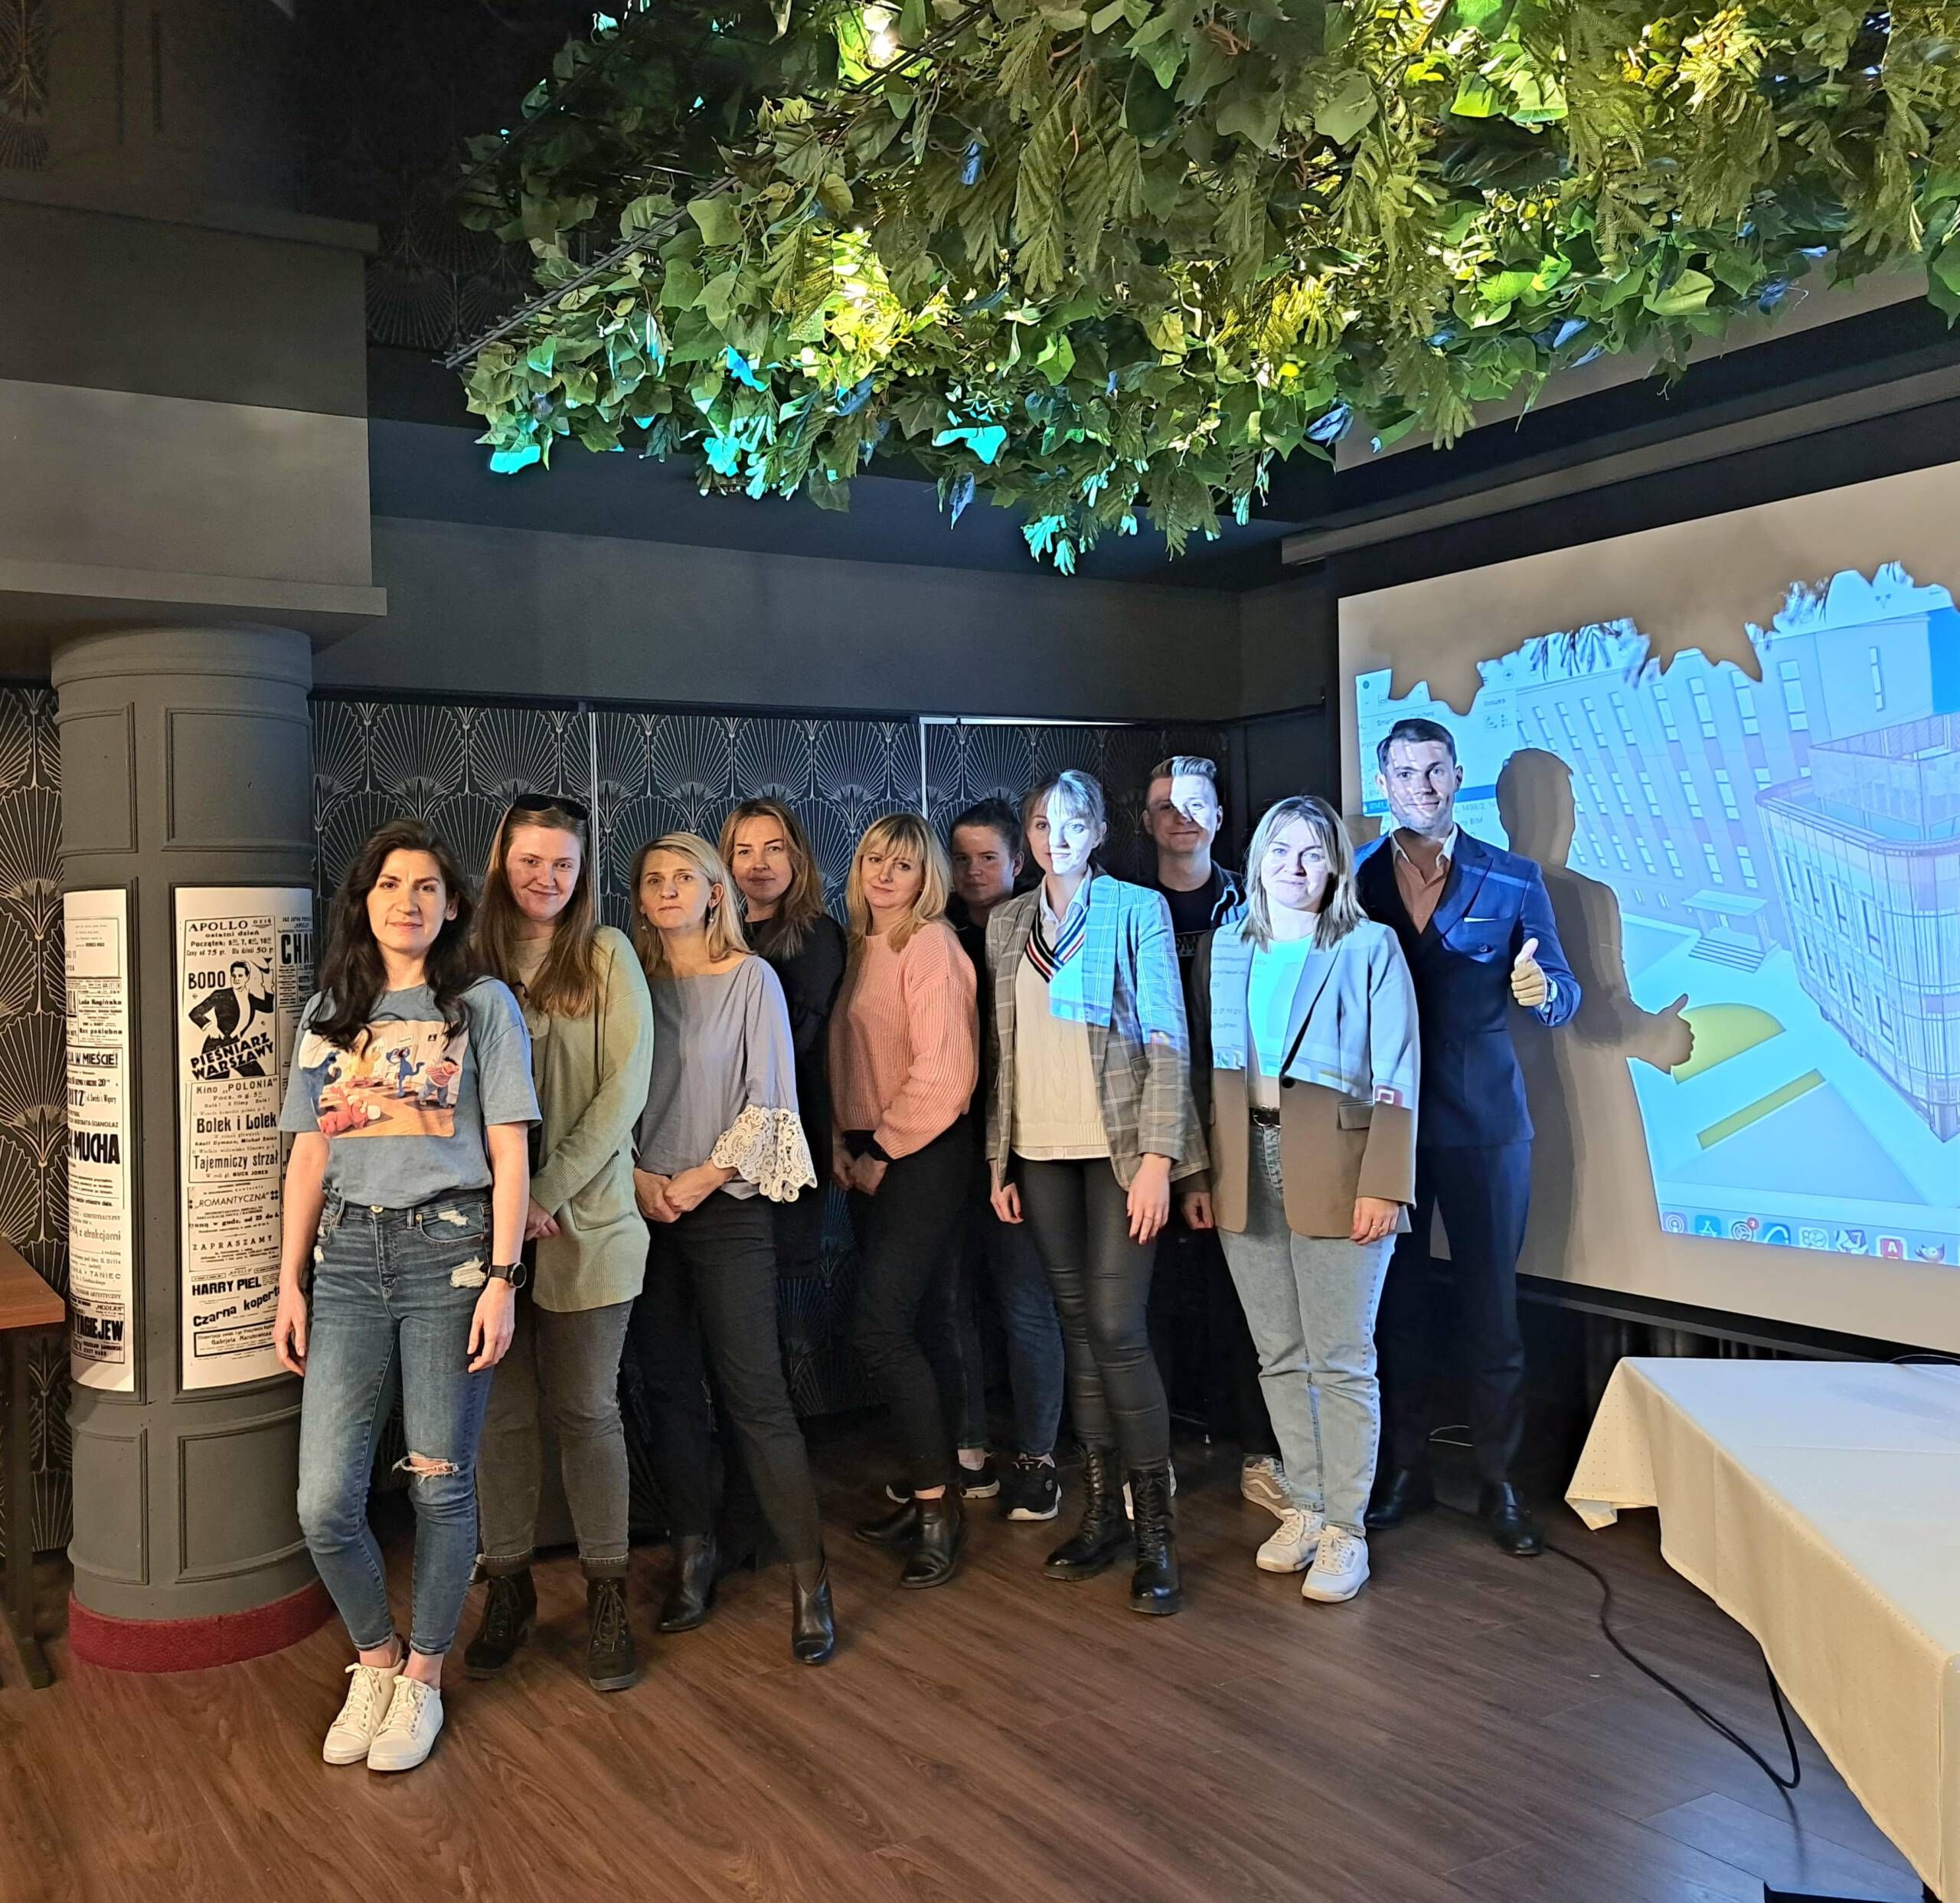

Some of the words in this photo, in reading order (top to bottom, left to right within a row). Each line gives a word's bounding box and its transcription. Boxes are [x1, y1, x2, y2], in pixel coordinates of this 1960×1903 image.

[188, 920, 248, 932] APOLLO
[188, 970, 226, 989] BODO
[190, 1032, 270, 1068] PIEŚNIARZ
[191, 1041, 273, 1081] WARSZAWY
[197, 1086, 217, 1094] Kino
[197, 1117, 231, 1133] Bolek
[237, 1116, 240, 1130] i
[246, 1111, 276, 1130] Lolek
[193, 1155, 248, 1172] Tajemniczy
[253, 1149, 279, 1166] strzał
[90, 1270, 121, 1280] TANIEC
[192, 1280, 234, 1296] HARRY
[237, 1277, 262, 1290] PIEL
[193, 1306, 237, 1327] Czarna
